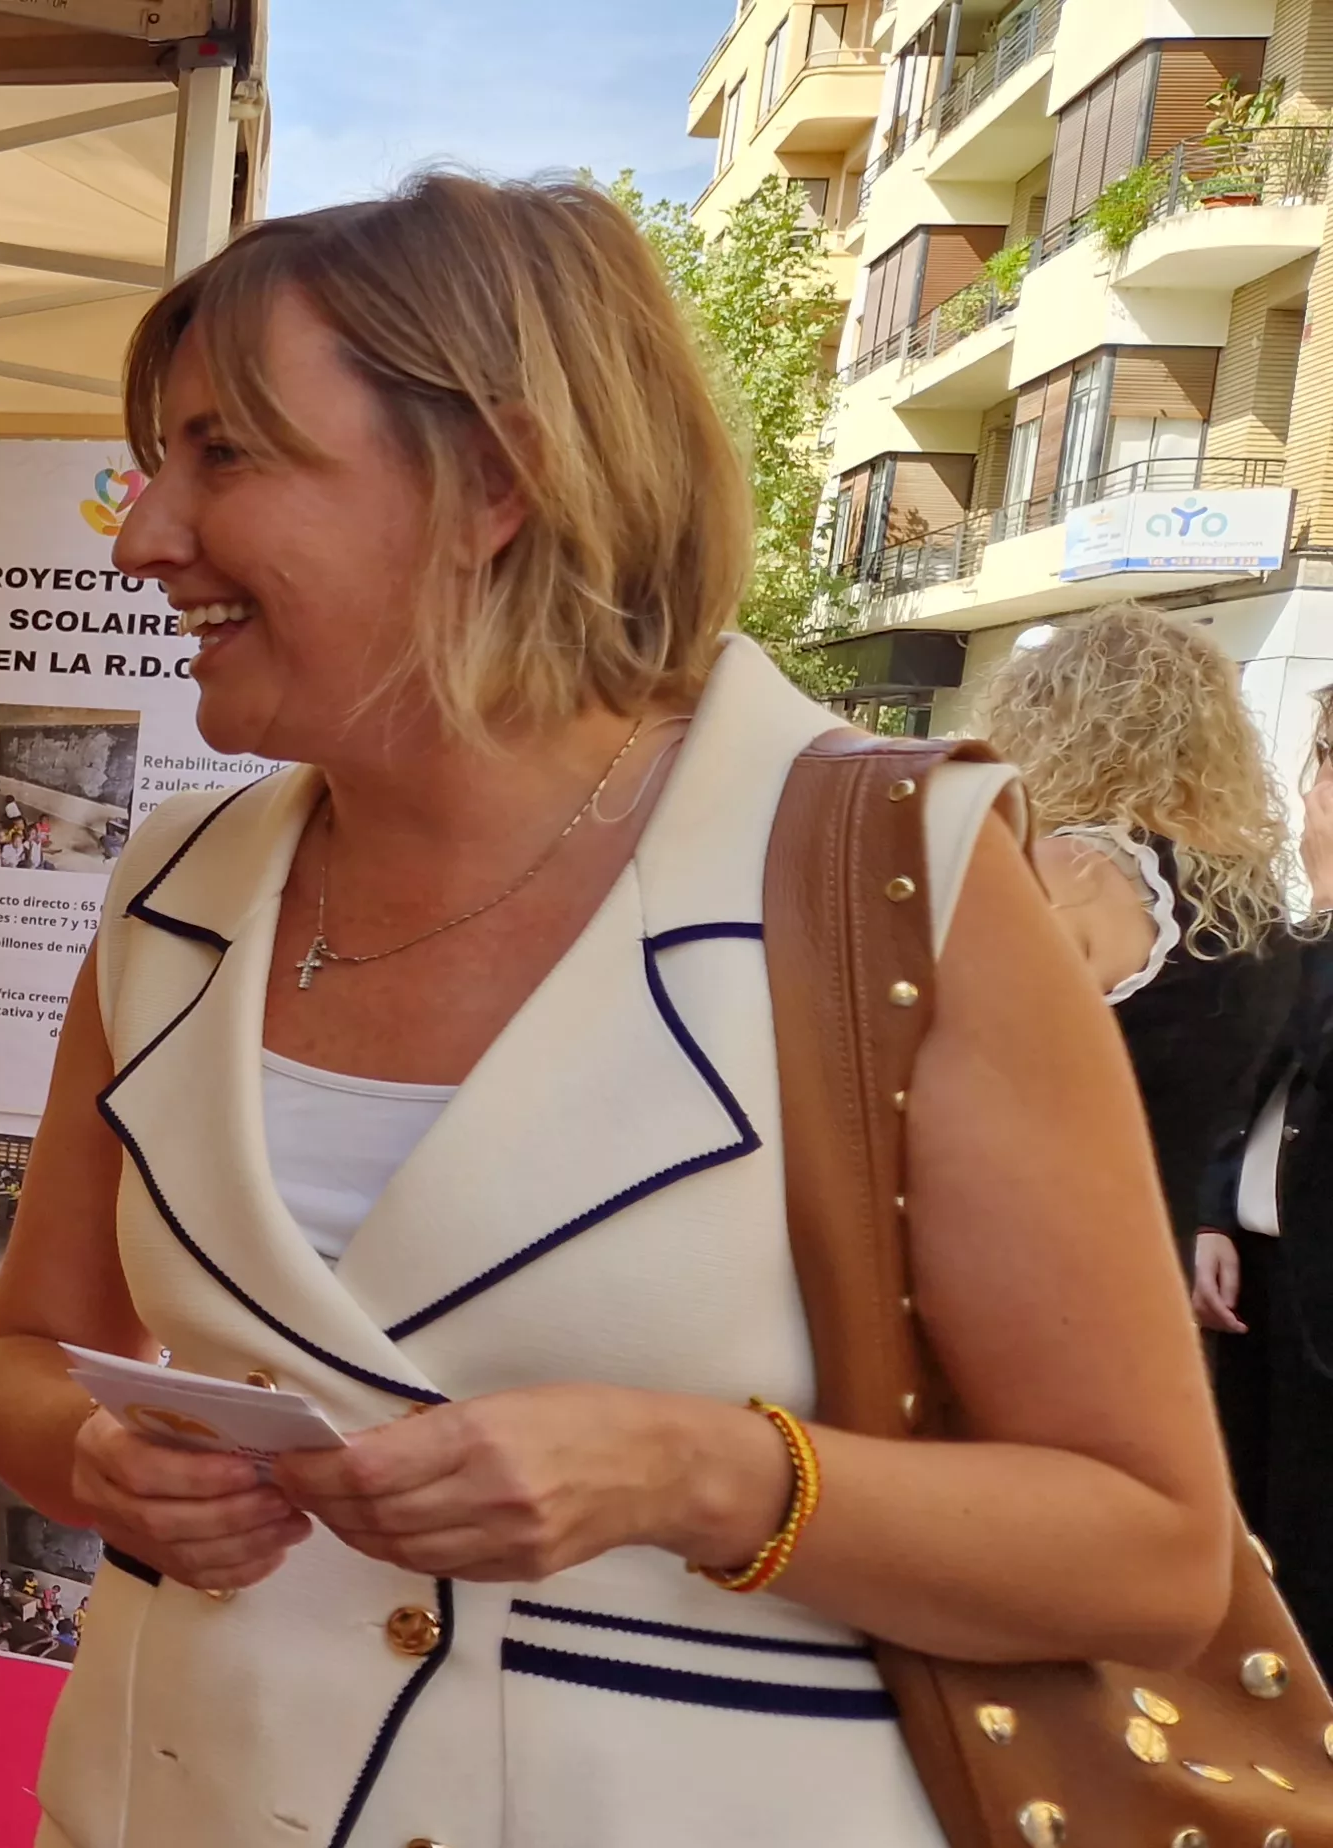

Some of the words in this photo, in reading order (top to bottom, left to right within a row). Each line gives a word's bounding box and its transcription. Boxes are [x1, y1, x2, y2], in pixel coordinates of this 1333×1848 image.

[9, 609, 180, 636] SCOLAIRE
[49, 652, 92, 675] LA
[104, 654, 191, 679] R.D.C
[143, 755, 265, 774] Rehabilitación
[270, 762, 288, 774] d
[140, 777, 150, 790] 2
[23, 897, 70, 910] directo
[81, 901, 96, 912] 65
[21, 916, 57, 927] entre
[61, 917, 68, 927] 7
[71, 920, 79, 931] y
[84, 919, 97, 930] 13
[47, 941, 63, 952] de
[66, 943, 89, 954] niñ
[37, 1012, 45, 1022] y
